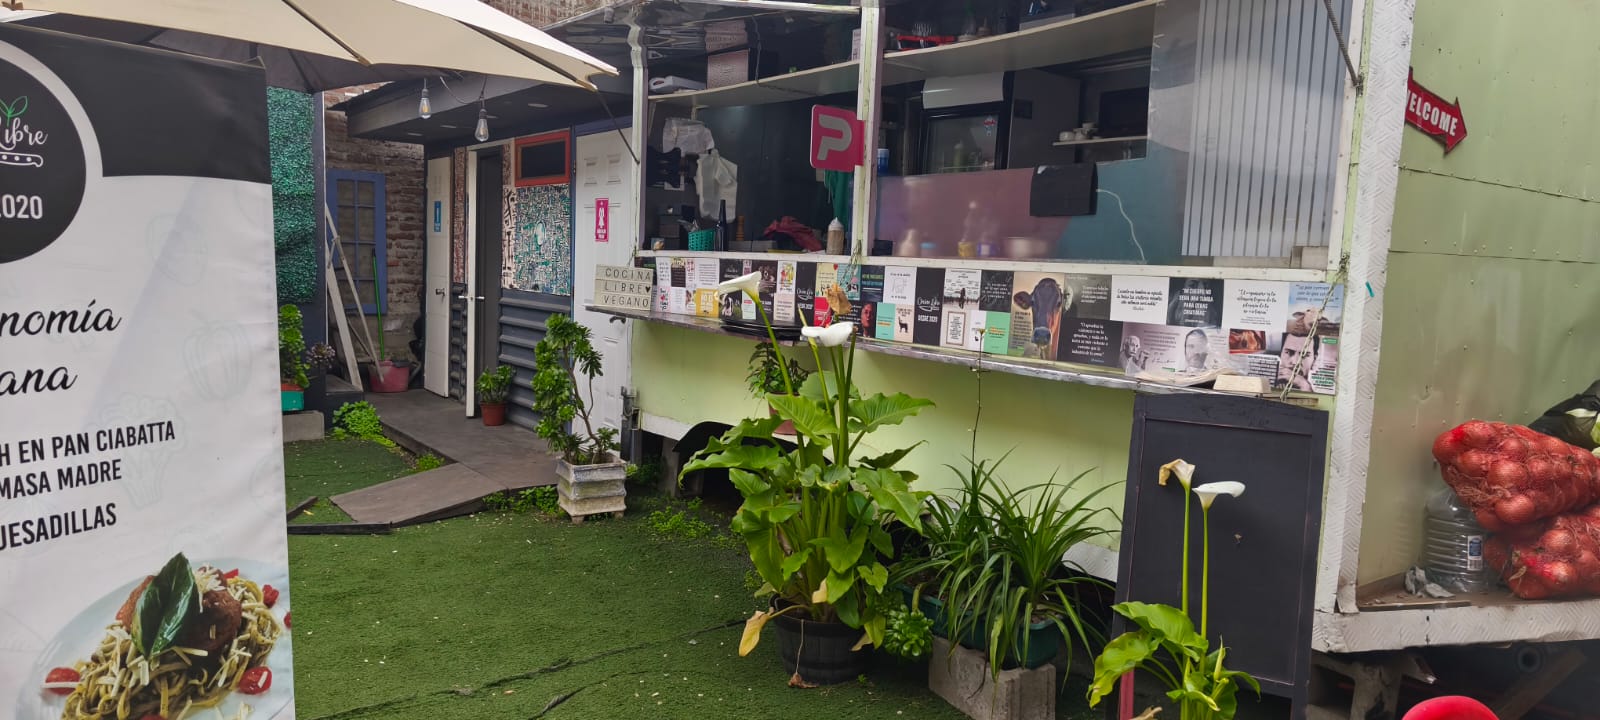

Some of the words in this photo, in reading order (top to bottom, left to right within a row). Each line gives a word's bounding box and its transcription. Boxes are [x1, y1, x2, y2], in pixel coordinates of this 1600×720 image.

[1407, 88, 1458, 136] ELCOME
[0, 194, 43, 220] 020
[604, 280, 643, 294] LIBRE
[605, 267, 651, 280] COCINA
[604, 295, 649, 308] VEGANO
[0, 299, 122, 337] nomía
[0, 366, 78, 396] ana
[18, 438, 45, 464] EN
[51, 431, 90, 459] PAN
[96, 420, 176, 452] CIABATTA
[0, 471, 51, 500] MASA
[57, 458, 122, 490] MADRE
